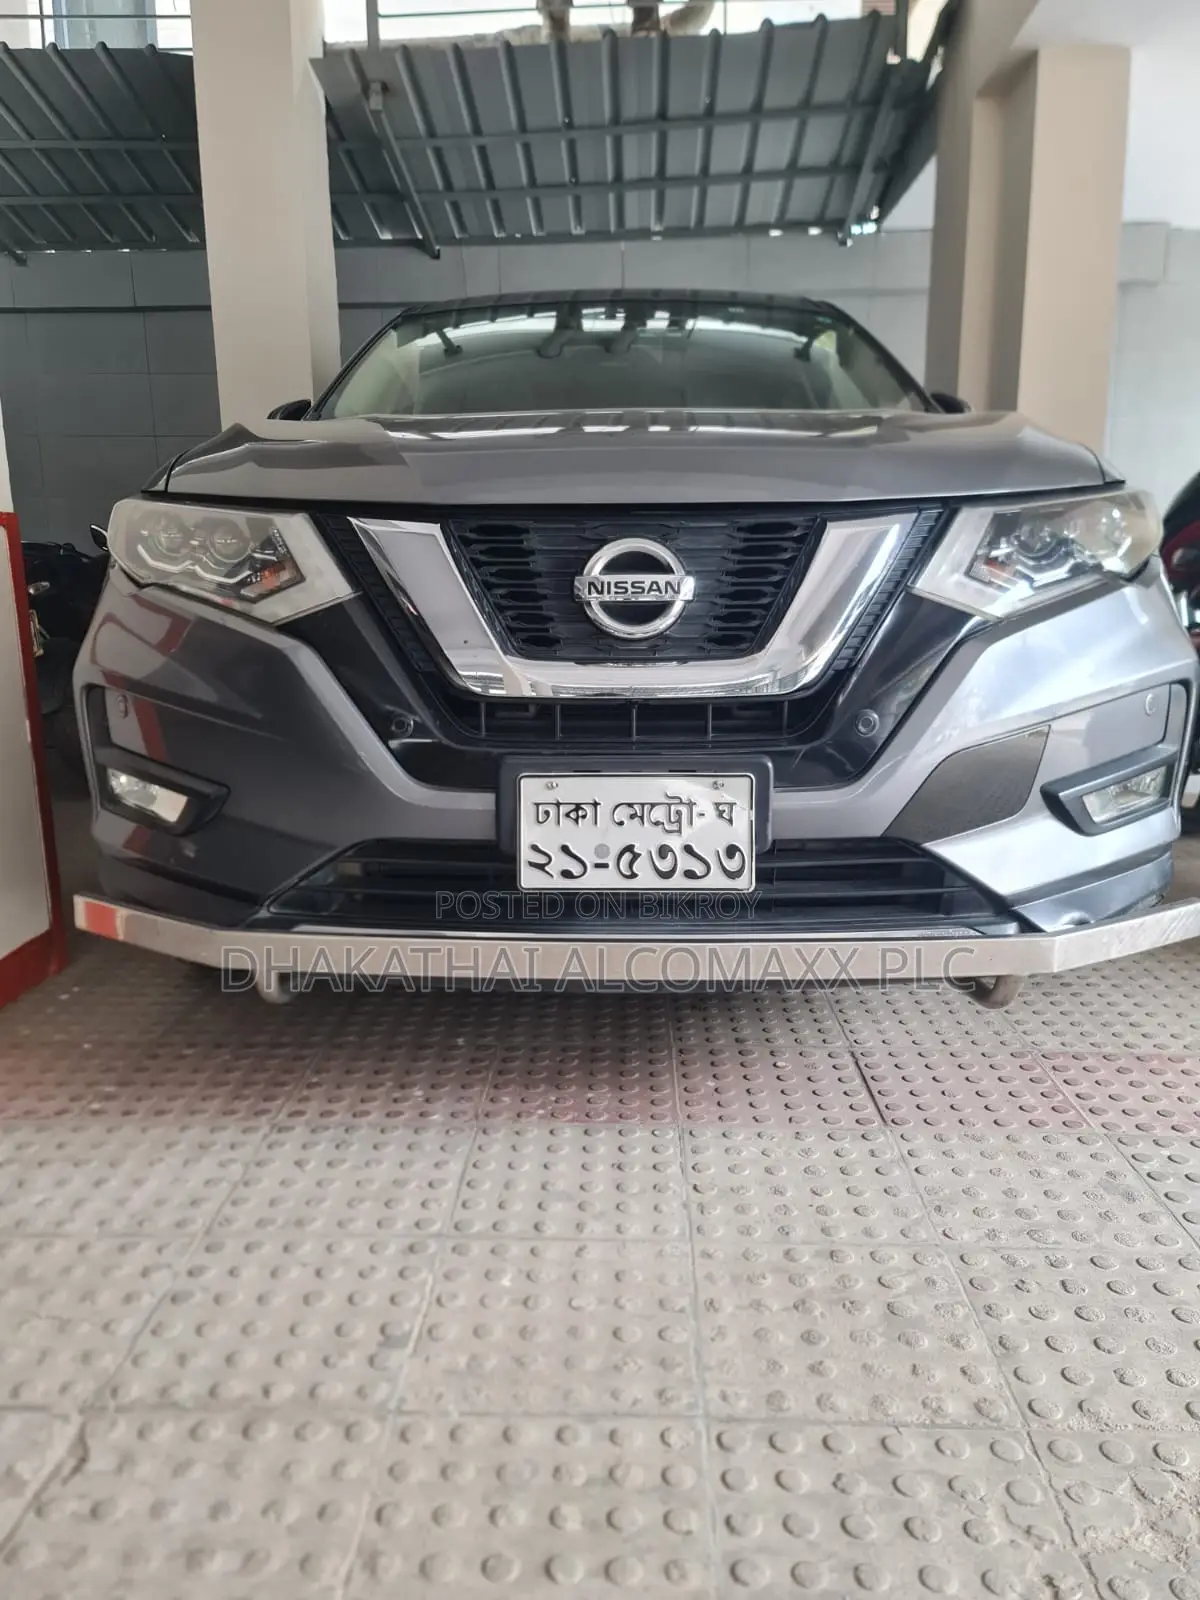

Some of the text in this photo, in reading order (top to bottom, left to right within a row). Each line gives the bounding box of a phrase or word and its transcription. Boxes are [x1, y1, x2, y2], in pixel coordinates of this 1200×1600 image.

[587, 580, 681, 596] NISSAN
[534, 797, 601, 827] ঢাকা
[527, 843, 746, 880] ২১-৫৩১৩
